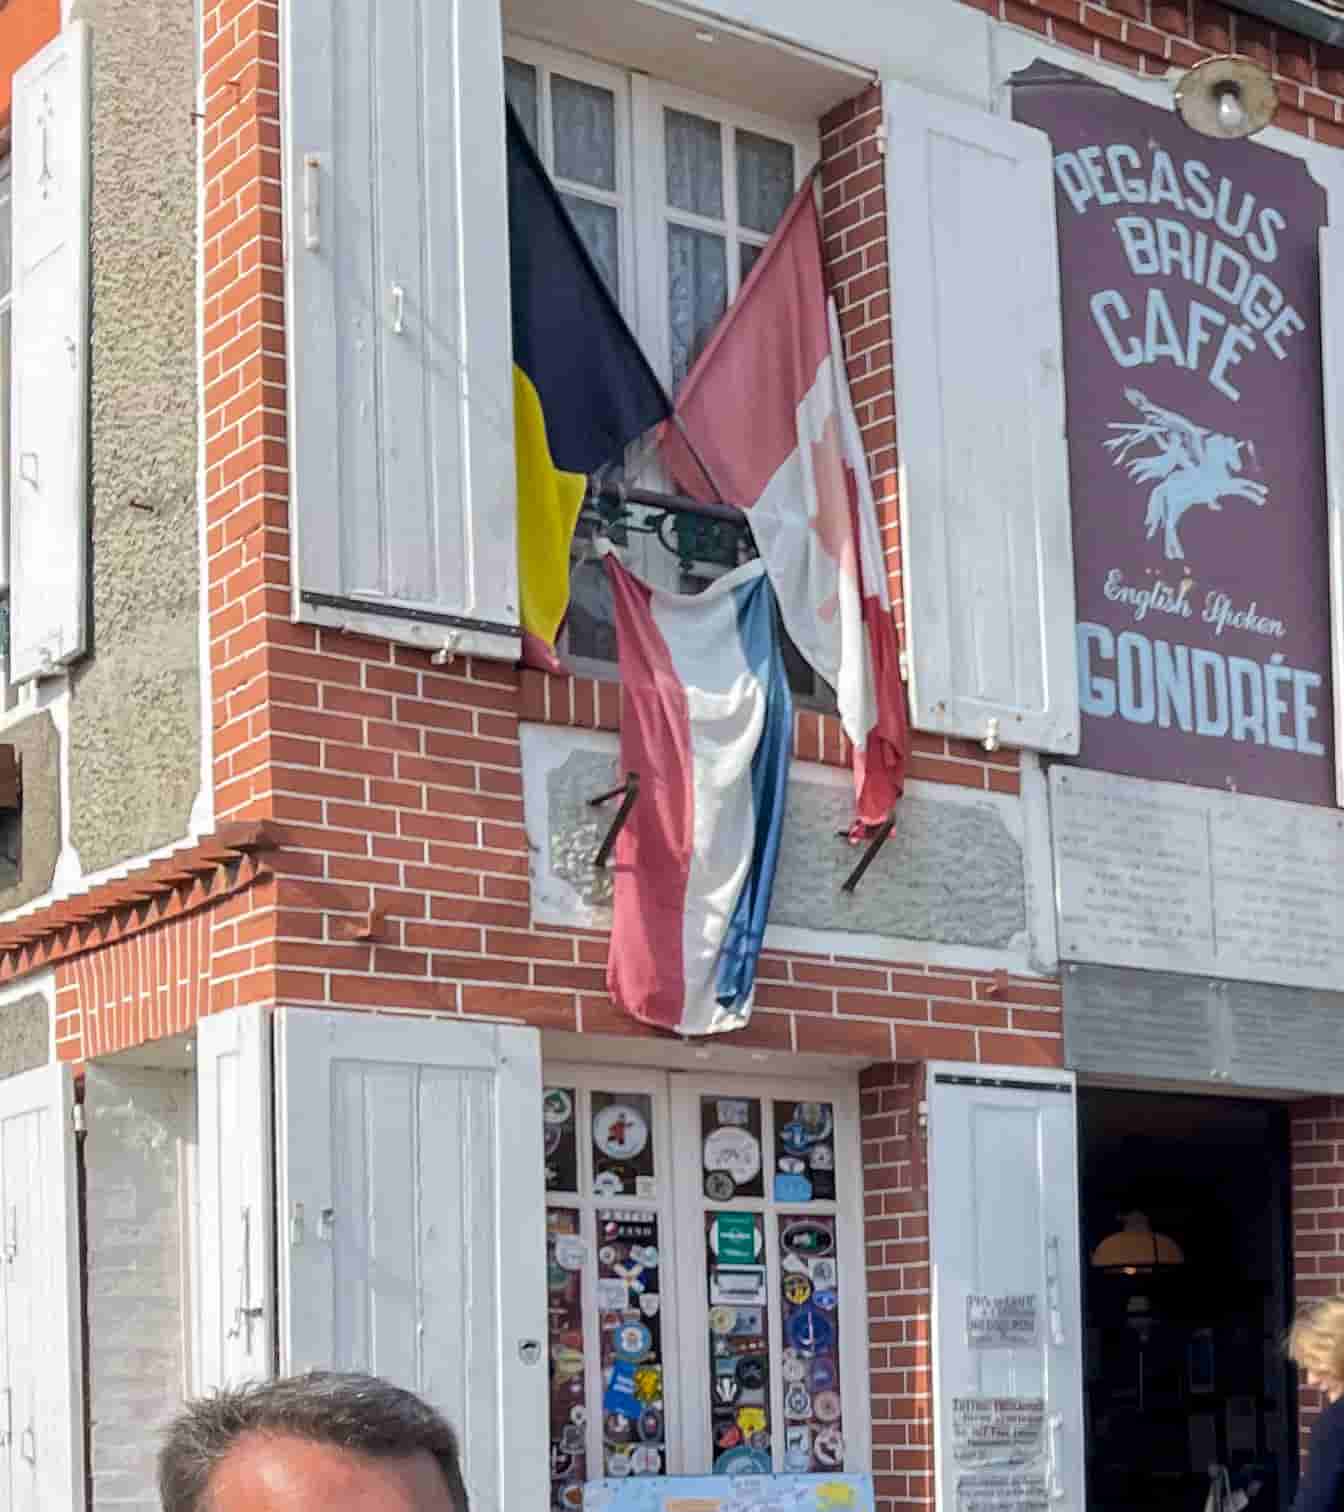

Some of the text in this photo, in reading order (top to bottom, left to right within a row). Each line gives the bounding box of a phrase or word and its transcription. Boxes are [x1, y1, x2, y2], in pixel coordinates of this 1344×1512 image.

[1055, 144, 1286, 262] PEGASUS
[1114, 216, 1305, 360] BRIDGE
[1103, 568, 1287, 638] English Spoken
[1078, 621, 1325, 756] GONDRÉE
